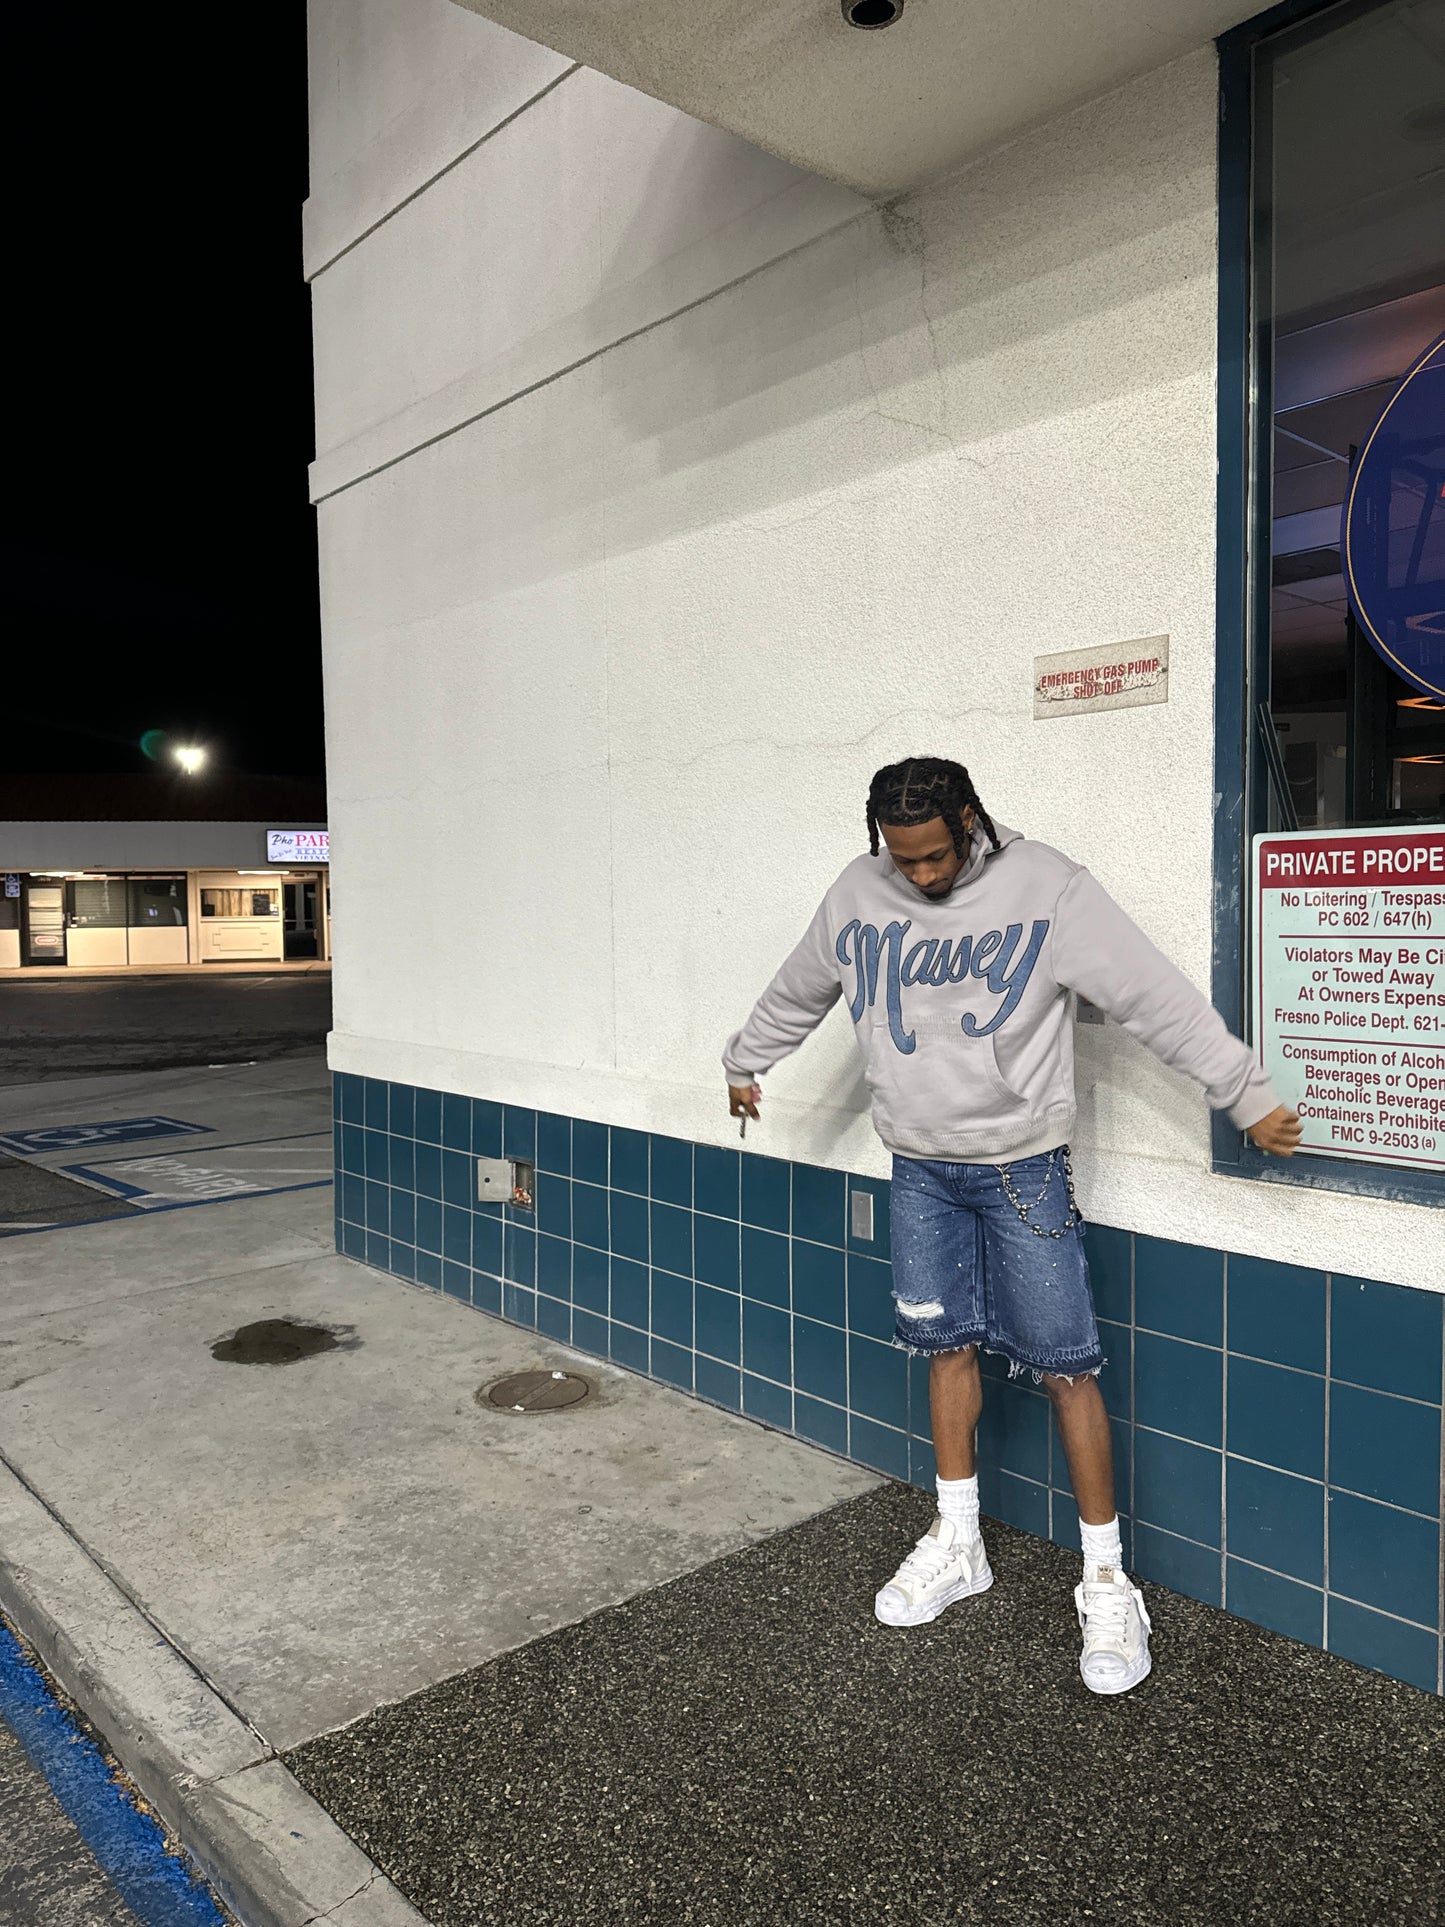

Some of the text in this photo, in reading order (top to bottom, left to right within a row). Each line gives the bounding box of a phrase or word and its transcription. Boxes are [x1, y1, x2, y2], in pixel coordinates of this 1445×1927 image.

[1041, 658, 1159, 688] EMERGENCY GAS PUMP
[1074, 680, 1122, 699] SHUT OFF
[272, 834, 329, 846] Pho PAR
[1266, 847, 1444, 876] PRIVATE PROPE
[1281, 891, 1445, 910] No Loitering / Trespas
[1318, 910, 1432, 930] PC 602 / 647(h)
[1285, 947, 1354, 963] Violators
[1358, 948, 1392, 968] May
[1398, 948, 1420, 964] Be
[836, 918, 1050, 1056] Massey
[1312, 968, 1435, 989] or Towed Away
[1298, 986, 1314, 1001] At
[1318, 986, 1380, 1004] Owners
[1274, 1008, 1320, 1024] Fresno
[1324, 1010, 1367, 1027] Police
[1371, 1013, 1409, 1033] Dept.
[1282, 1043, 1377, 1066] Consumption
[1381, 1051, 1397, 1066] of
[1305, 1064, 1445, 1092] Beverages or Open
[1305, 1084, 1372, 1104] Alcoholic
[1297, 1102, 1375, 1124] Containers
[1331, 1125, 1437, 1152] FMC 9-2503 (a)
